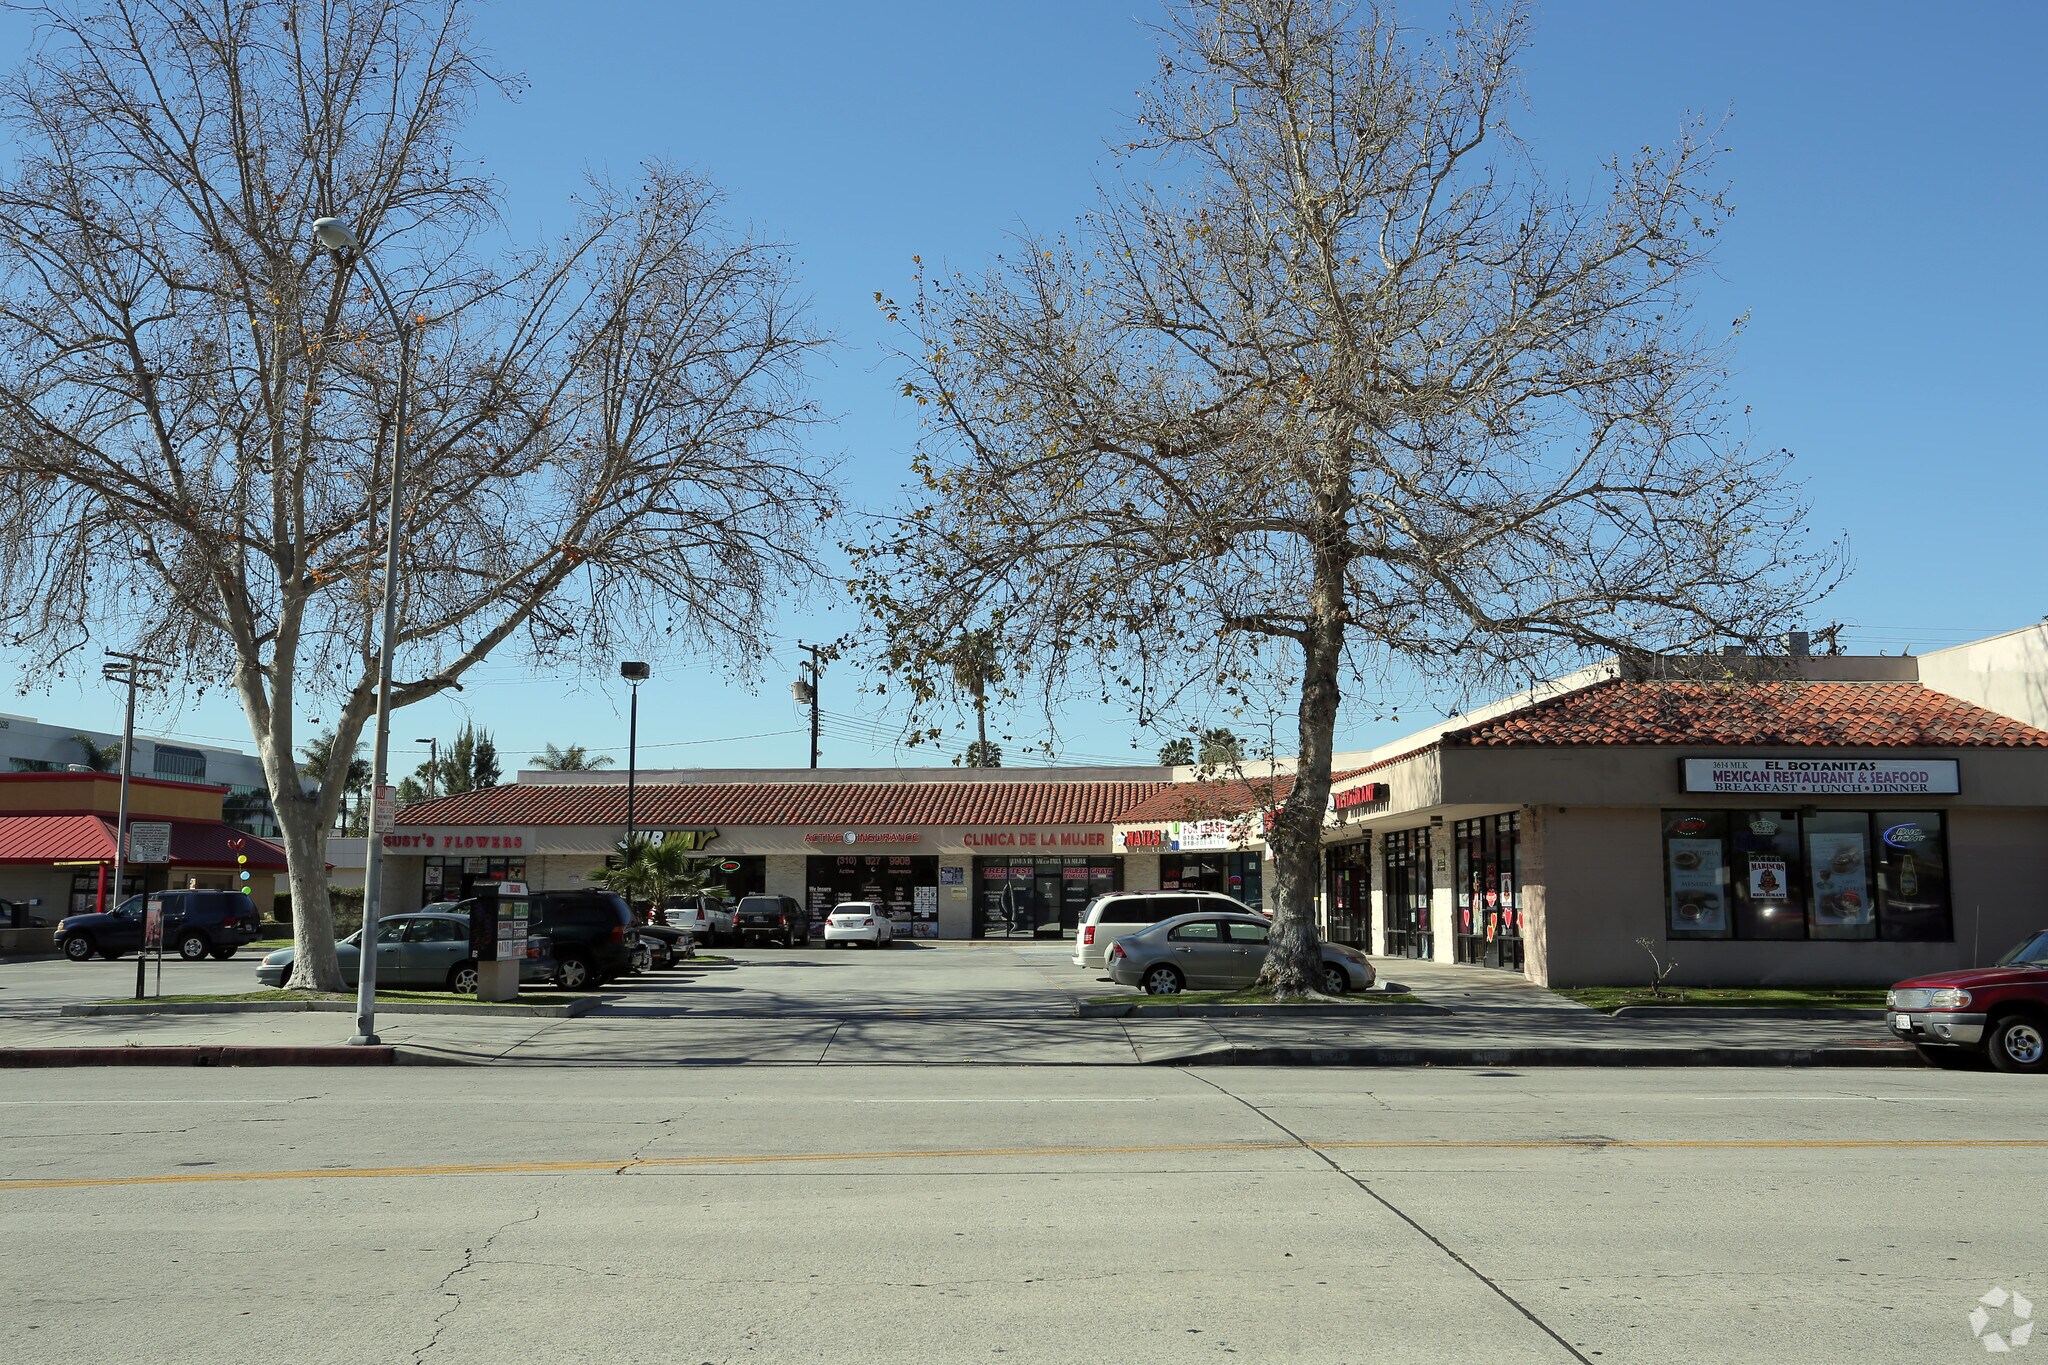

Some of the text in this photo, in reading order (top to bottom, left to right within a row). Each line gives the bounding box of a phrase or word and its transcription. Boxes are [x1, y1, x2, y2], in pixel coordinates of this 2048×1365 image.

[1713, 761, 1728, 769] 3614
[1765, 761, 1783, 770] EL
[1787, 761, 1876, 771] BOTANITAS
[1713, 770, 1929, 784] MEXICAN RESTAURANT & SEAFOOD
[376, 787, 385, 799] NO
[1715, 783, 1929, 793] BREAKFAST LUNCH DINNER
[1183, 824, 1198, 834] FOR
[1200, 823, 1225, 833] LEASE
[383, 833, 522, 848] SUSY'S FLOWERS
[804, 832, 920, 843] ACTIVE INSURANCE
[963, 833, 1105, 846] CLINICA DE LA MUJER
[1126, 829, 1161, 846] NAILS
[837, 856, 857, 866] (310)
[889, 856, 911, 865] 9908
[1751, 862, 1785, 871] MARISCOS
